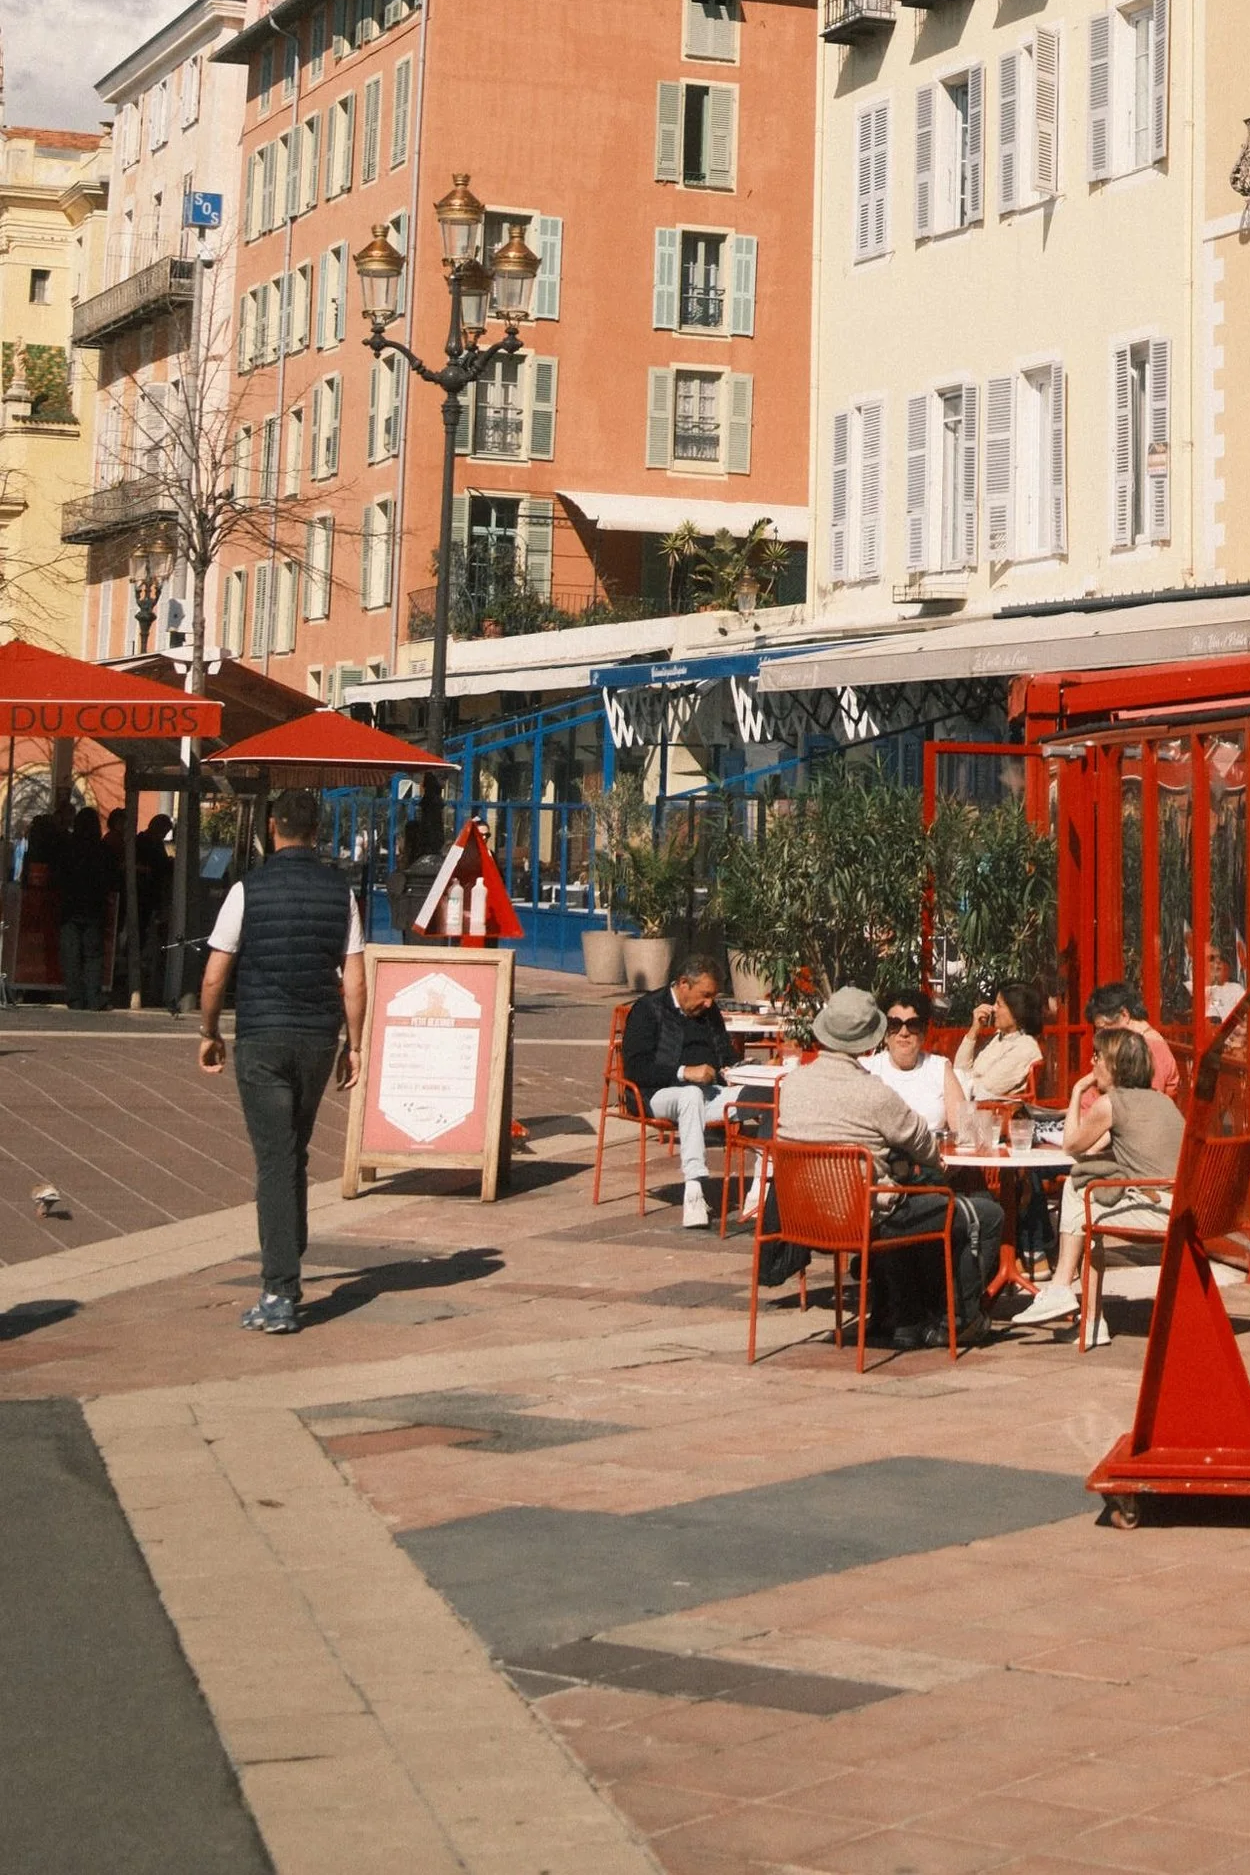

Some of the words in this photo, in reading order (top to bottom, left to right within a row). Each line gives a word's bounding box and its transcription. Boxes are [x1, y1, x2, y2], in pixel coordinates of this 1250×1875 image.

[194, 192, 220, 225] SOS
[11, 705, 63, 733] DU
[76, 705, 199, 734] COURS
